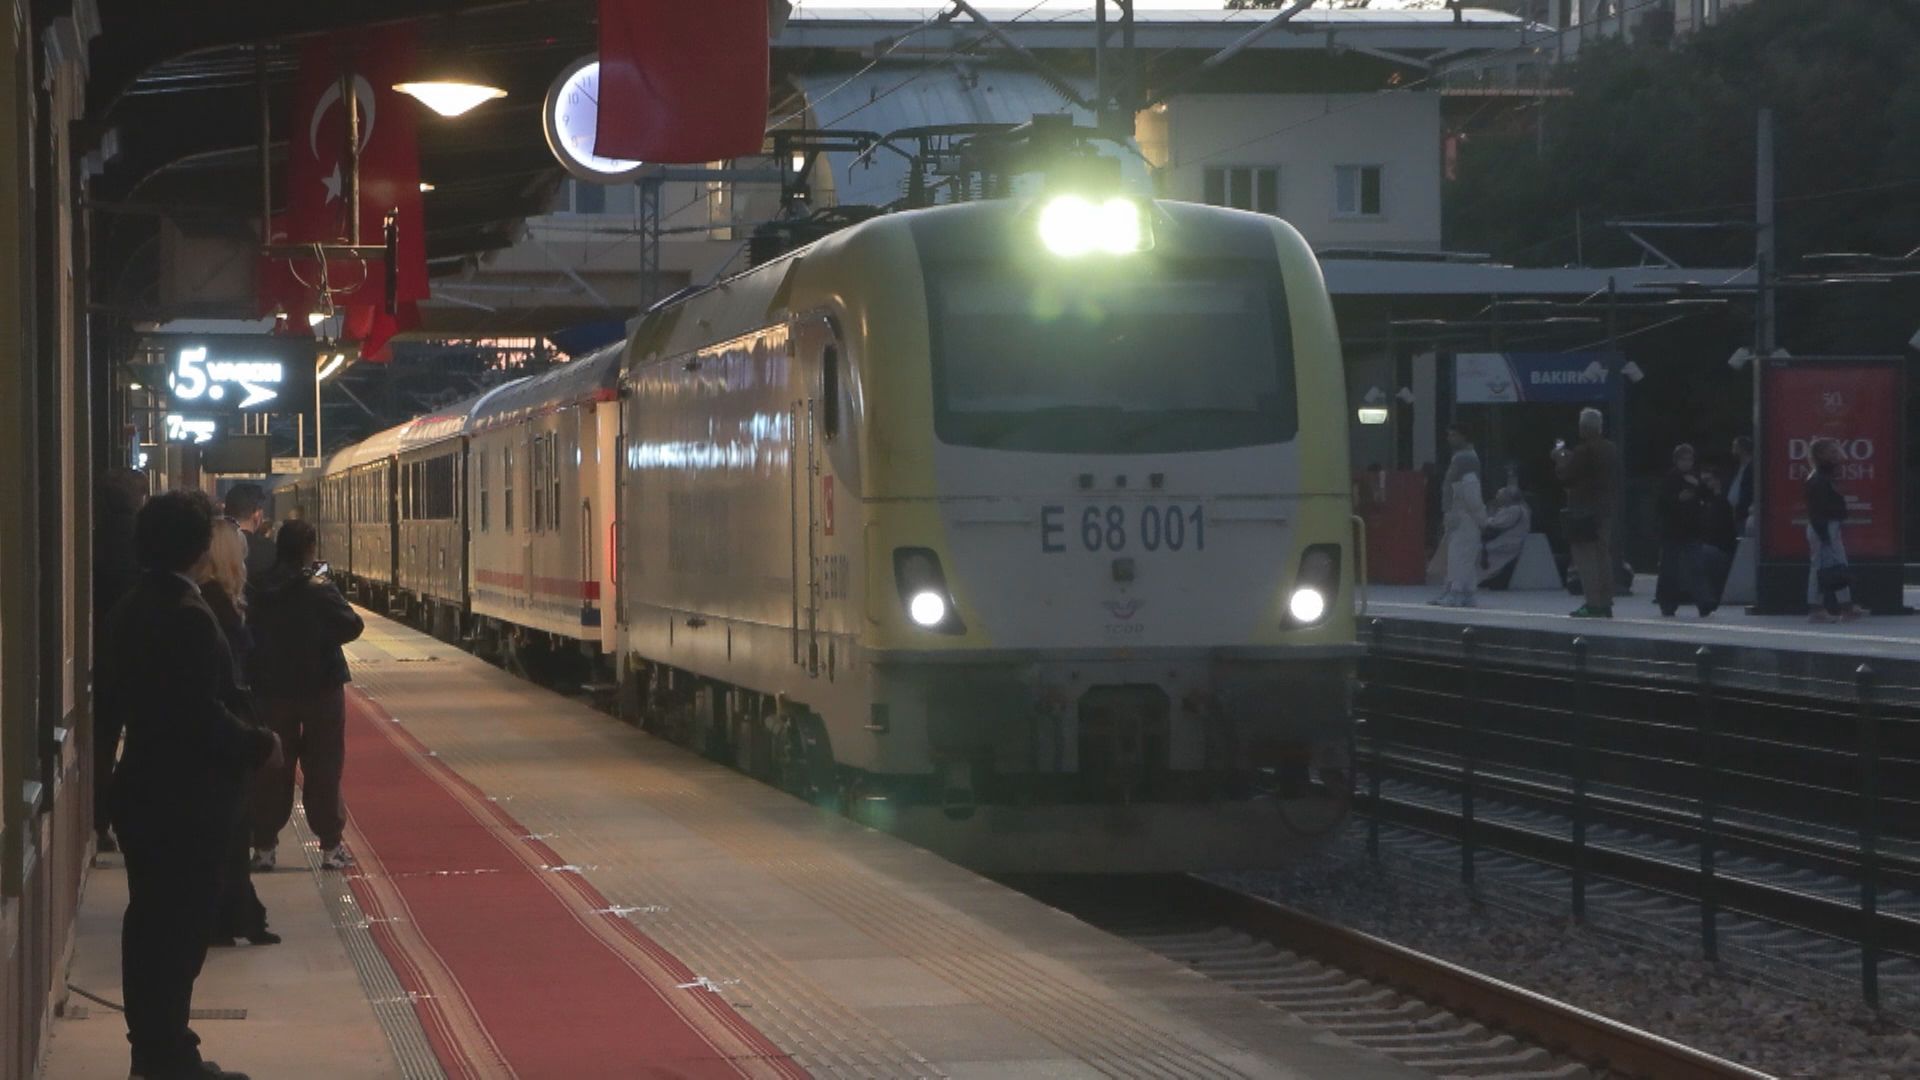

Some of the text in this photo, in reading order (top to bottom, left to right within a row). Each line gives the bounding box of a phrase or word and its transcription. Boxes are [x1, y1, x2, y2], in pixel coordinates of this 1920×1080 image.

[582, 76, 592, 88] 11
[567, 93, 579, 104] 10
[562, 115, 570, 125] 9
[174, 346, 225, 400] 5.
[1789, 438, 1874, 460] DKO
[1041, 504, 1205, 553] E 68 001
